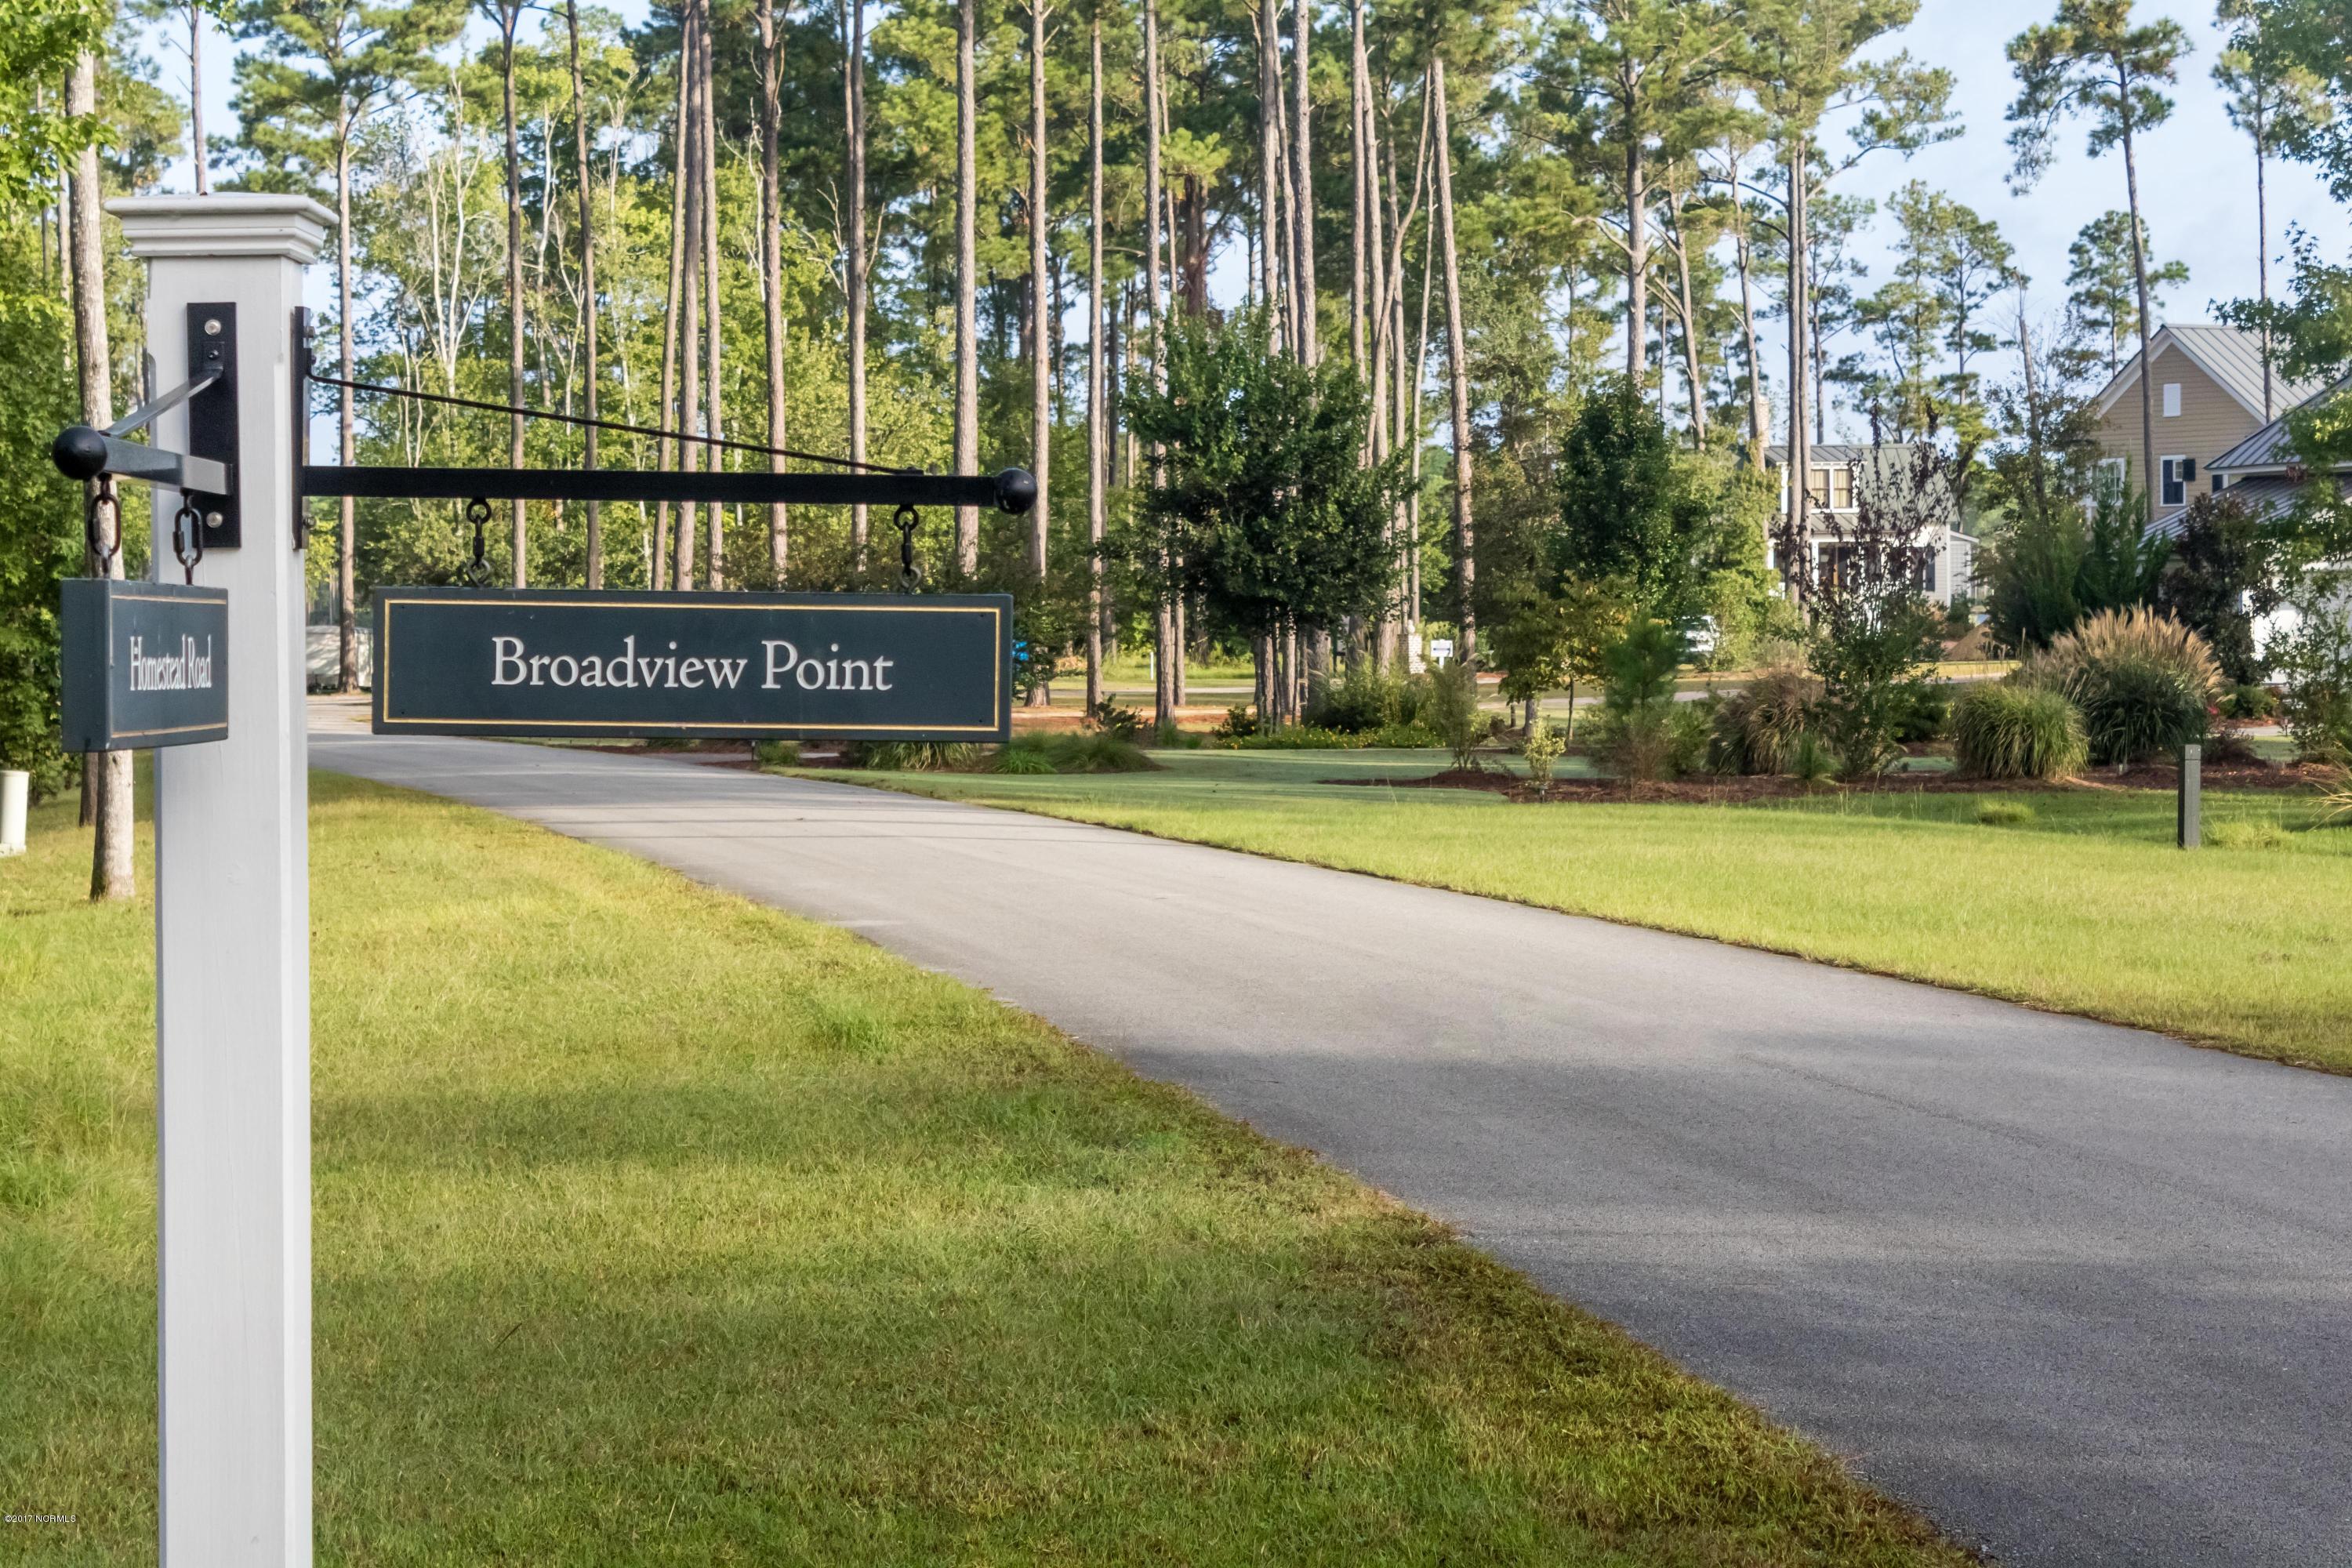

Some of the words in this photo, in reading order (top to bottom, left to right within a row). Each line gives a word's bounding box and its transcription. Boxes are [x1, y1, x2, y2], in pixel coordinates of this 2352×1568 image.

[130, 634, 186, 691] Homestead
[187, 634, 212, 689] Road
[492, 635, 747, 689] Broadview
[761, 639, 893, 691] Point
